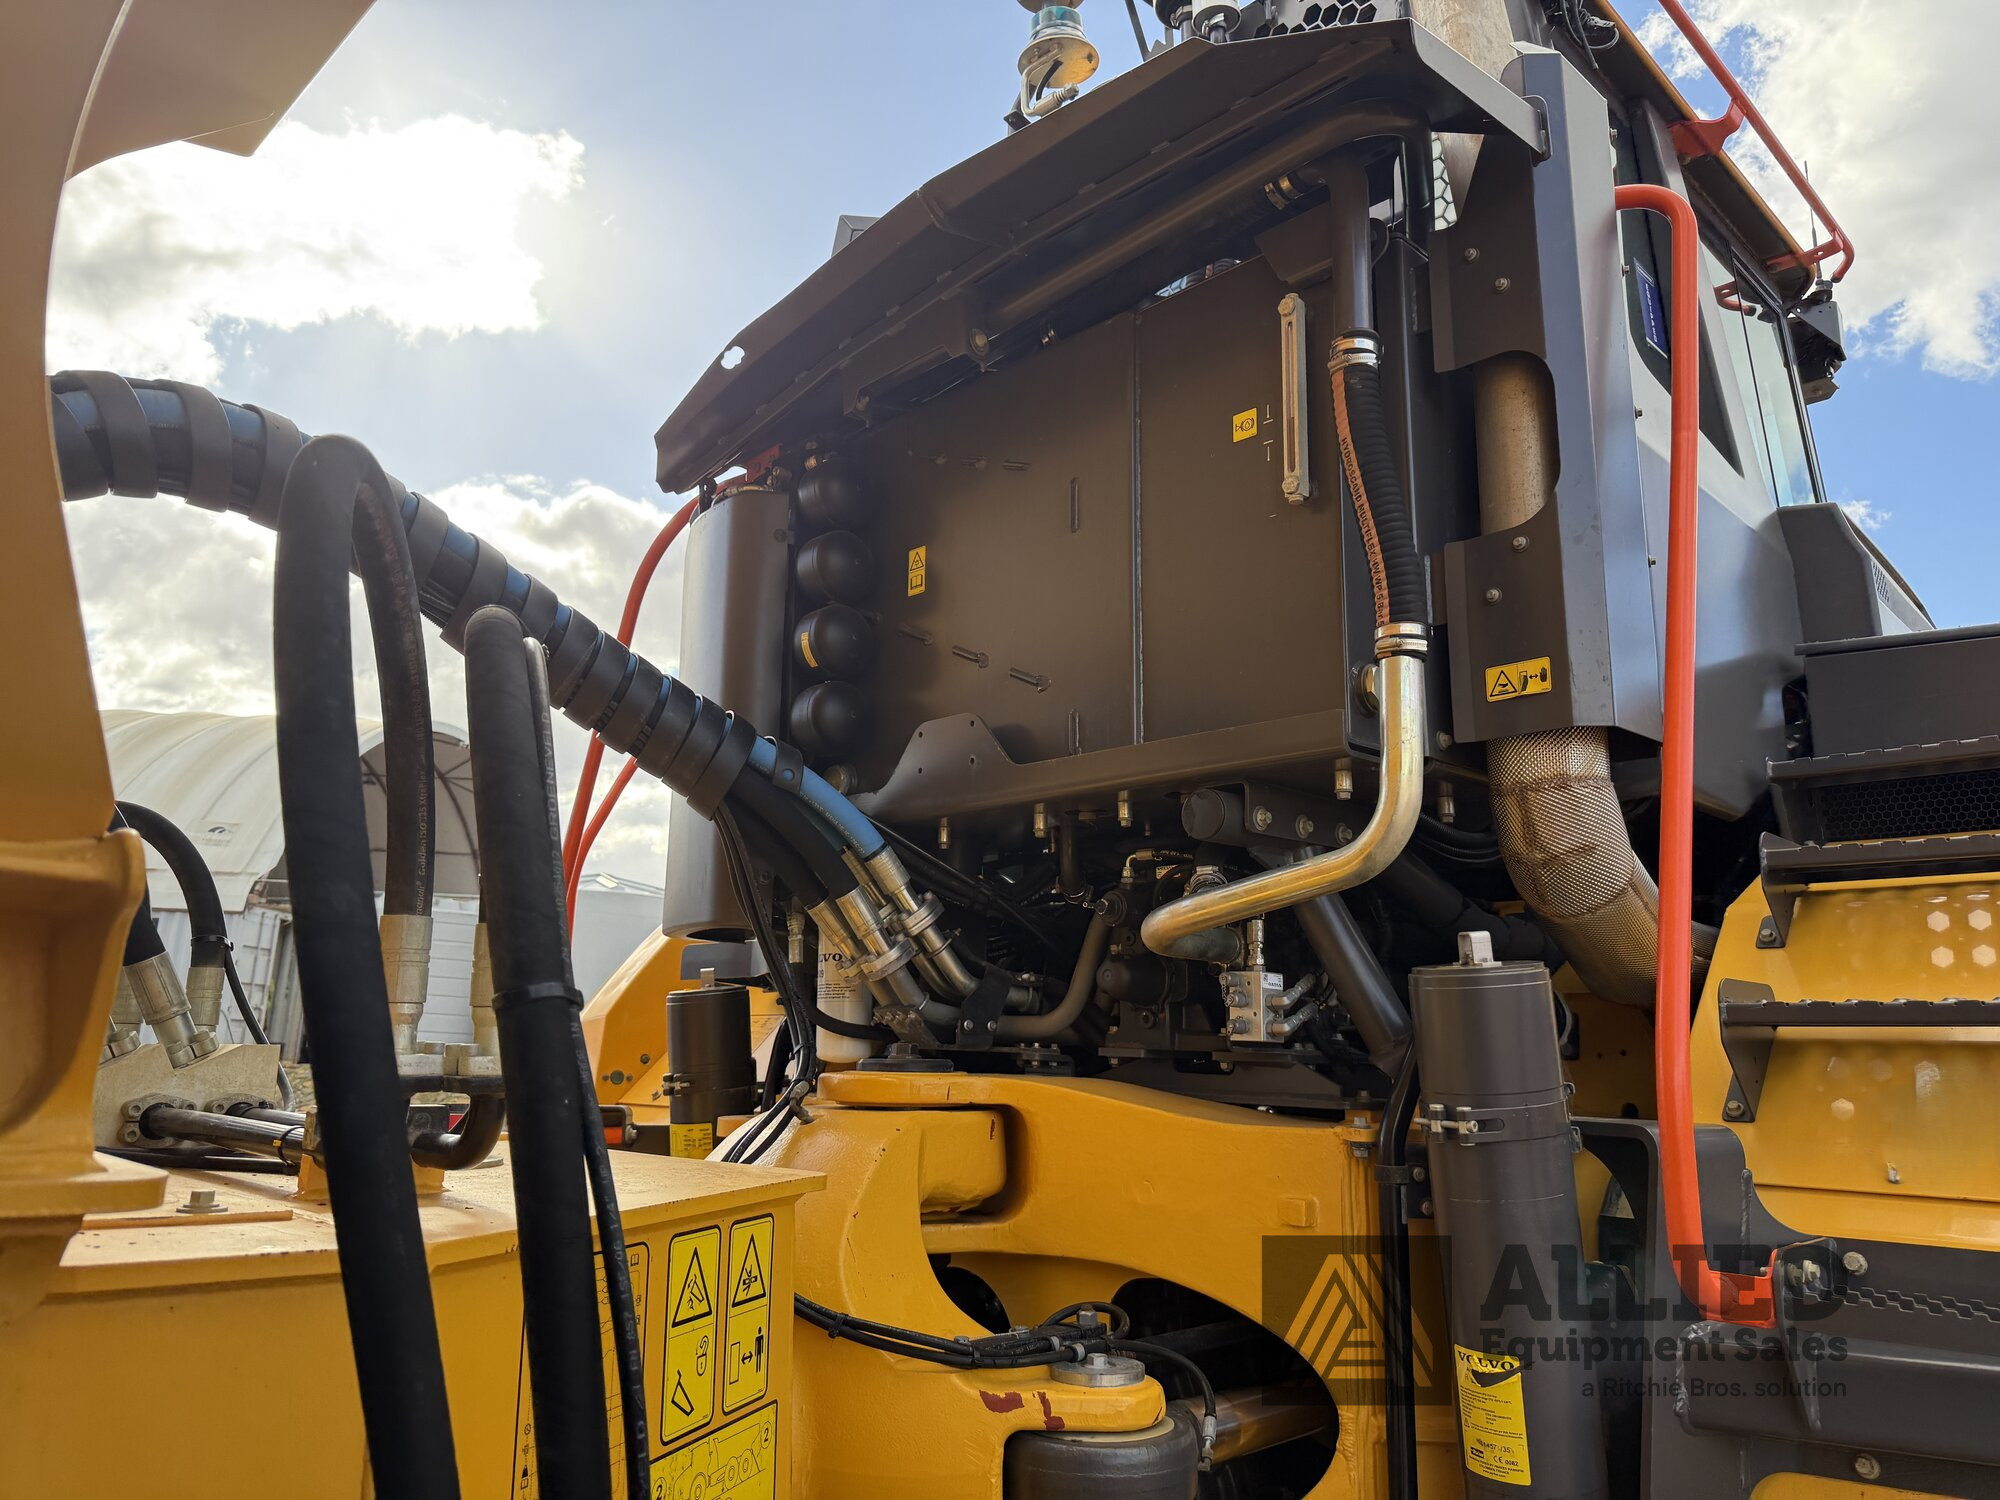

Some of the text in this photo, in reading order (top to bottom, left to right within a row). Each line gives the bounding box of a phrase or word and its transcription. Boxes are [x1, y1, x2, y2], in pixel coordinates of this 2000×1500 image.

[1341, 437, 1362, 502] HYDROSCAND
[1357, 503, 1376, 557] MULTIFLEX
[763, 1427, 770, 1443] 2
